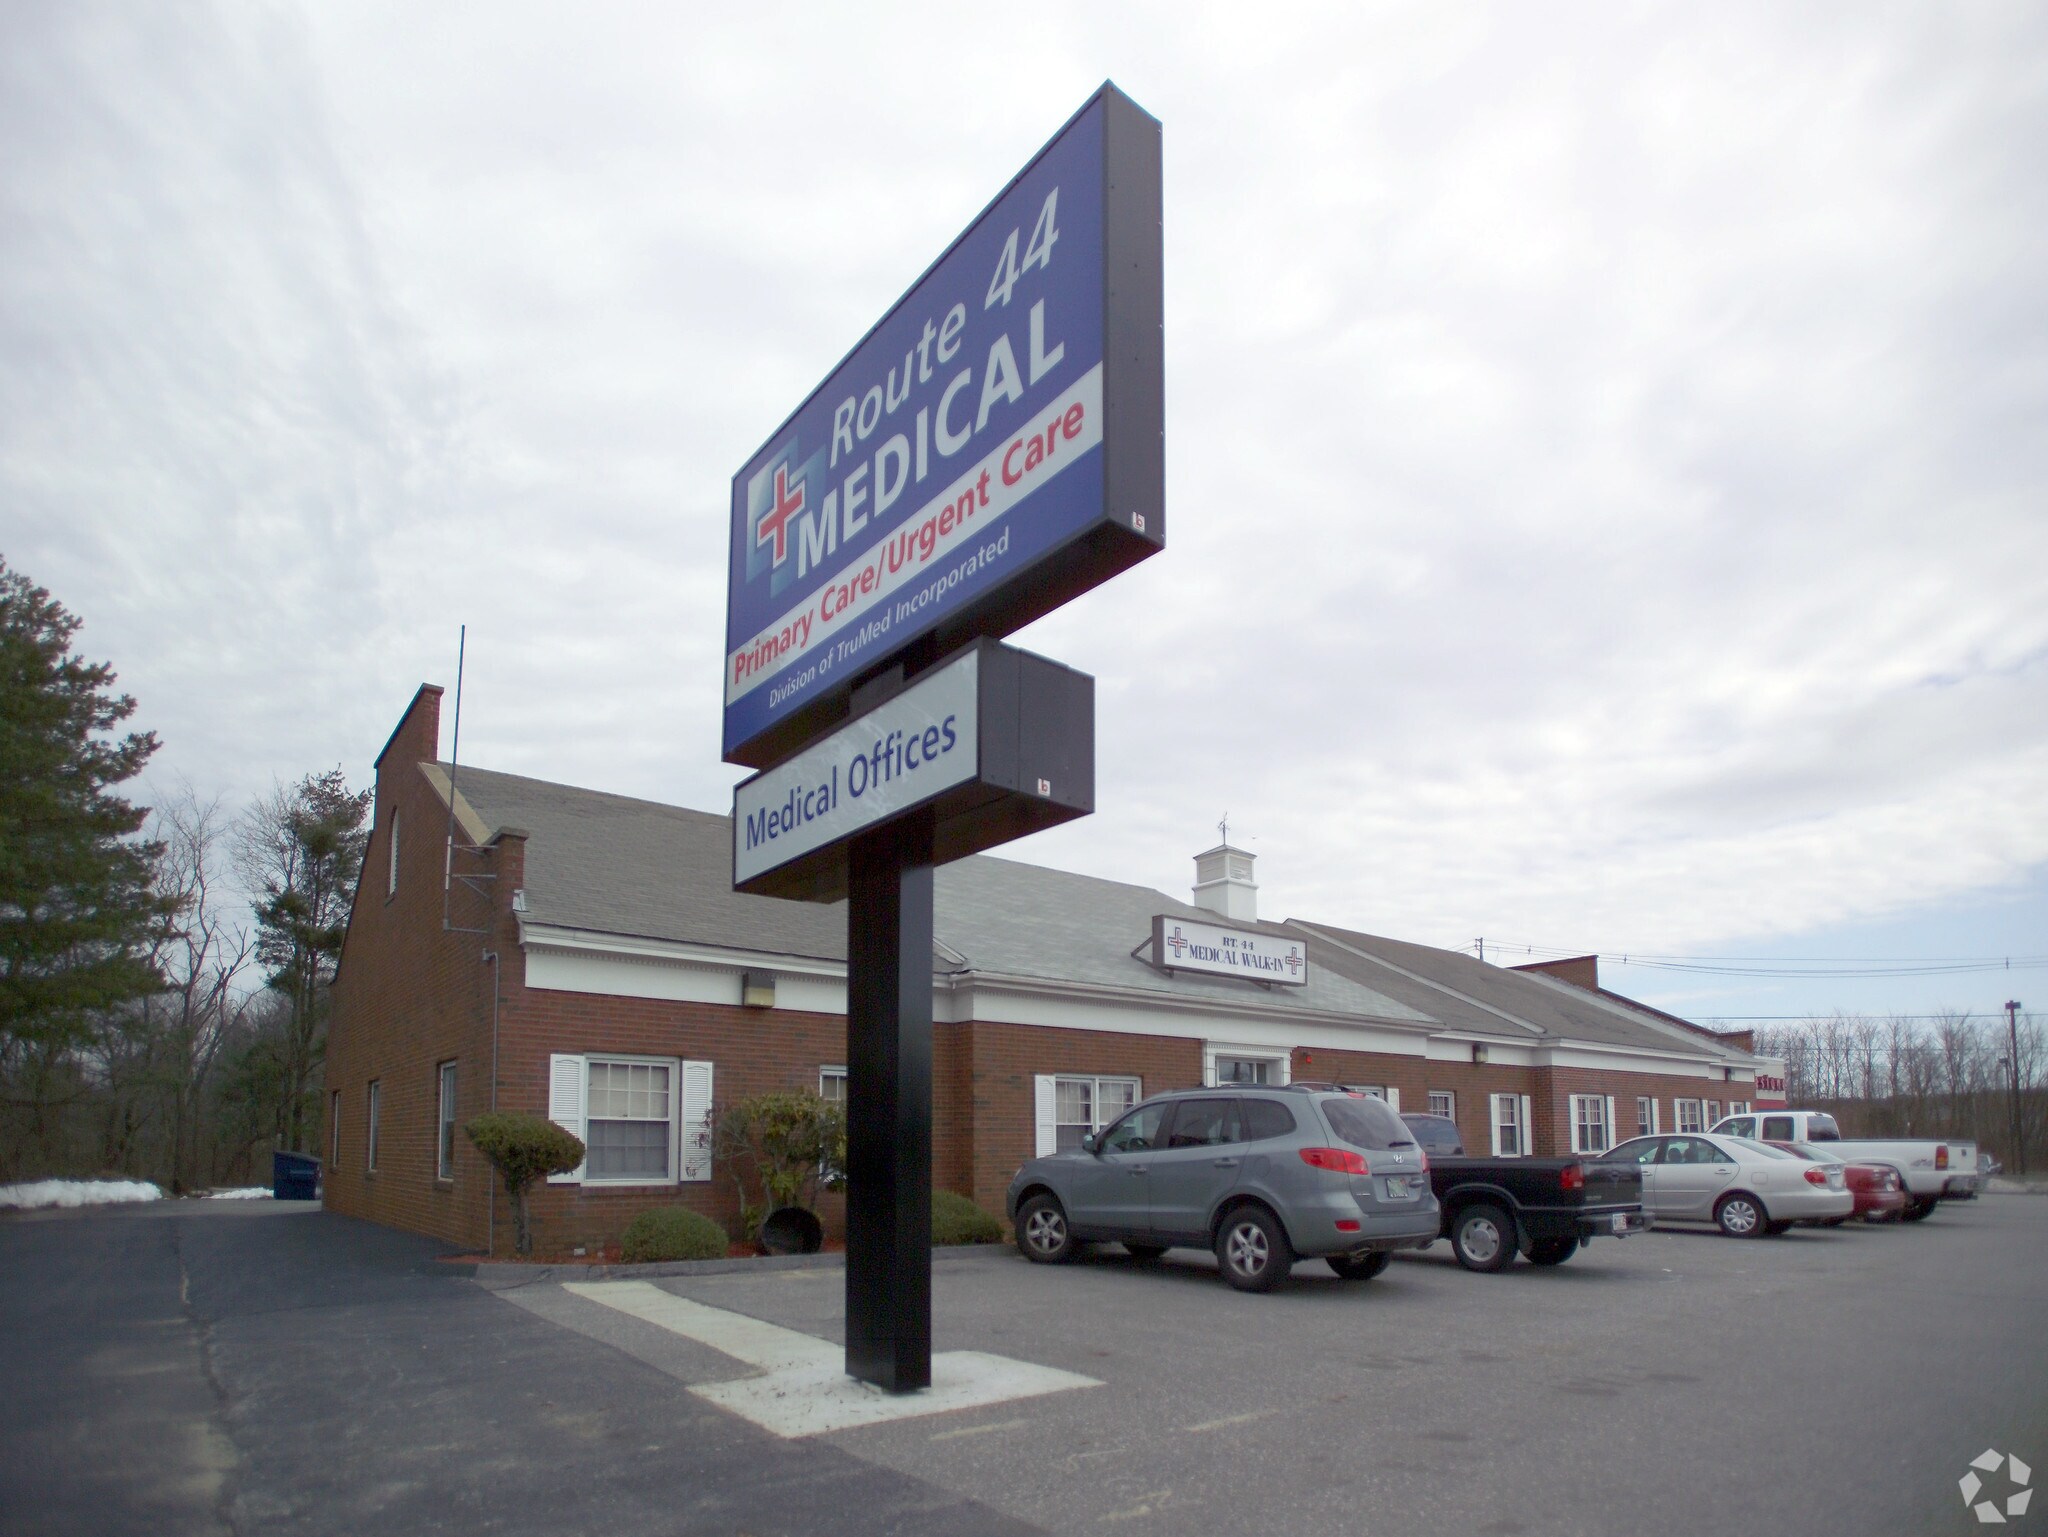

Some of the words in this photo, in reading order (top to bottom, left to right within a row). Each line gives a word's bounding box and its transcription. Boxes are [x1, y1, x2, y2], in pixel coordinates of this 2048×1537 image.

[829, 302, 966, 469] Route
[985, 186, 1059, 311] 44
[797, 298, 1065, 578] MEDICAL
[734, 608, 814, 685] Primary
[820, 472, 990, 622] Care/Urgent
[1001, 402, 1085, 487] Care
[769, 666, 815, 709] Division
[819, 651, 834, 675] of
[837, 608, 891, 663] TruMed
[896, 526, 1010, 624] Incorporated
[746, 765, 838, 851] Medical
[848, 714, 957, 800] Offices
[1189, 944, 1238, 965] MEDICAL
[1241, 952, 1283, 972] WALK-IN
[1222, 937, 1239, 948] RT.
[1241, 940, 1254, 950] 44
